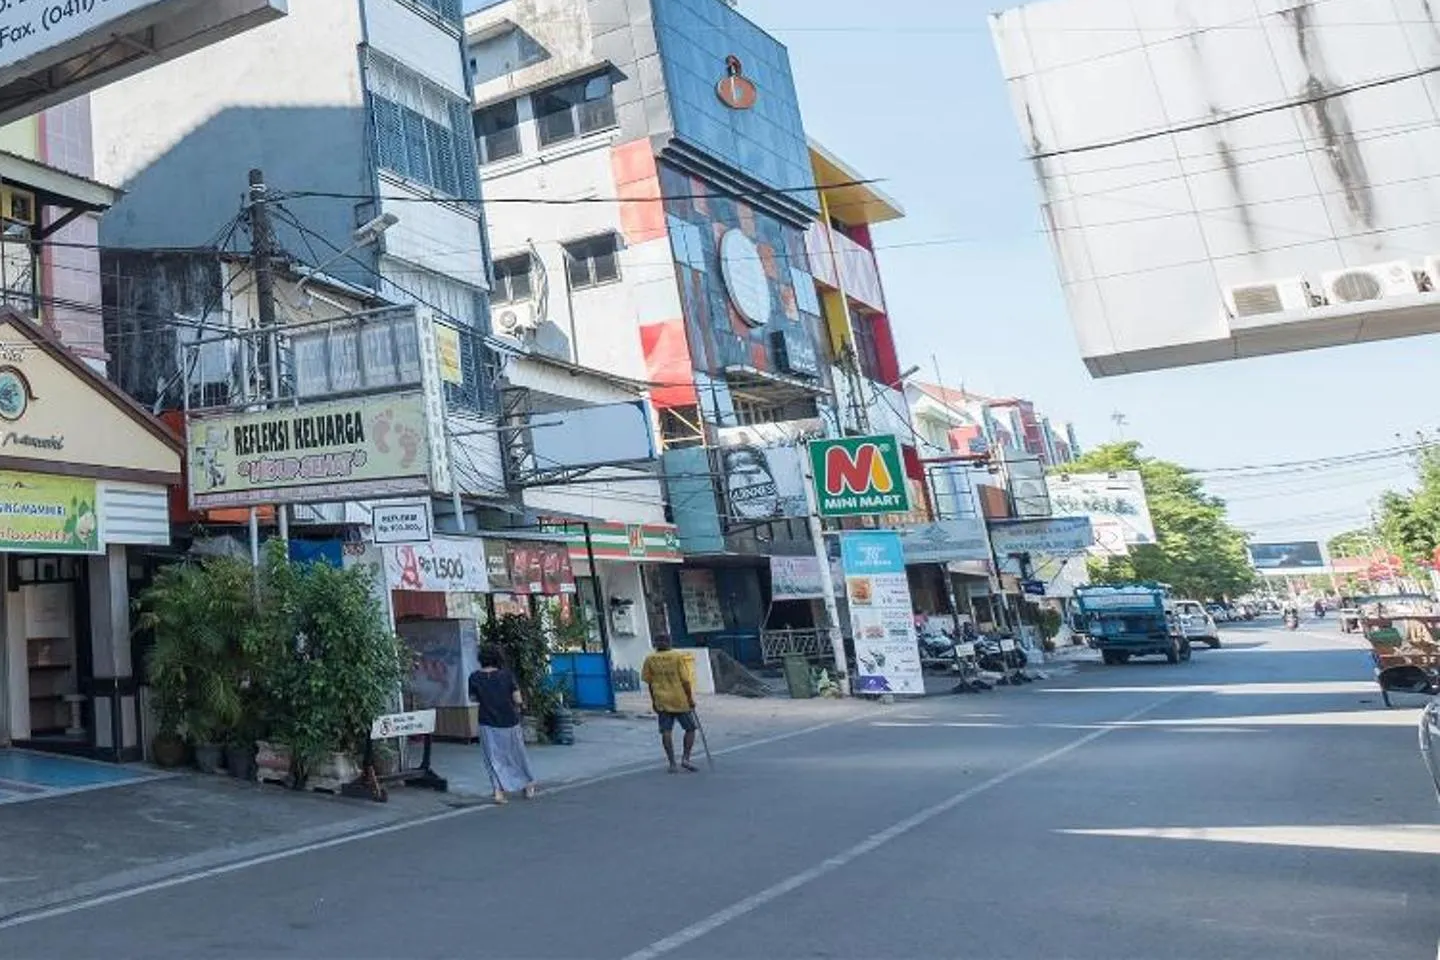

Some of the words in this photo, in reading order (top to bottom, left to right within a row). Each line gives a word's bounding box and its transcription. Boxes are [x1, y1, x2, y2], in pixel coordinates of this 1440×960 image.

[0, 20, 37, 50] Fax.
[234, 419, 290, 456] REFLEKSI
[293, 411, 365, 450] KELUARGA
[824, 497, 858, 510] MINI
[860, 493, 902, 508] MART
